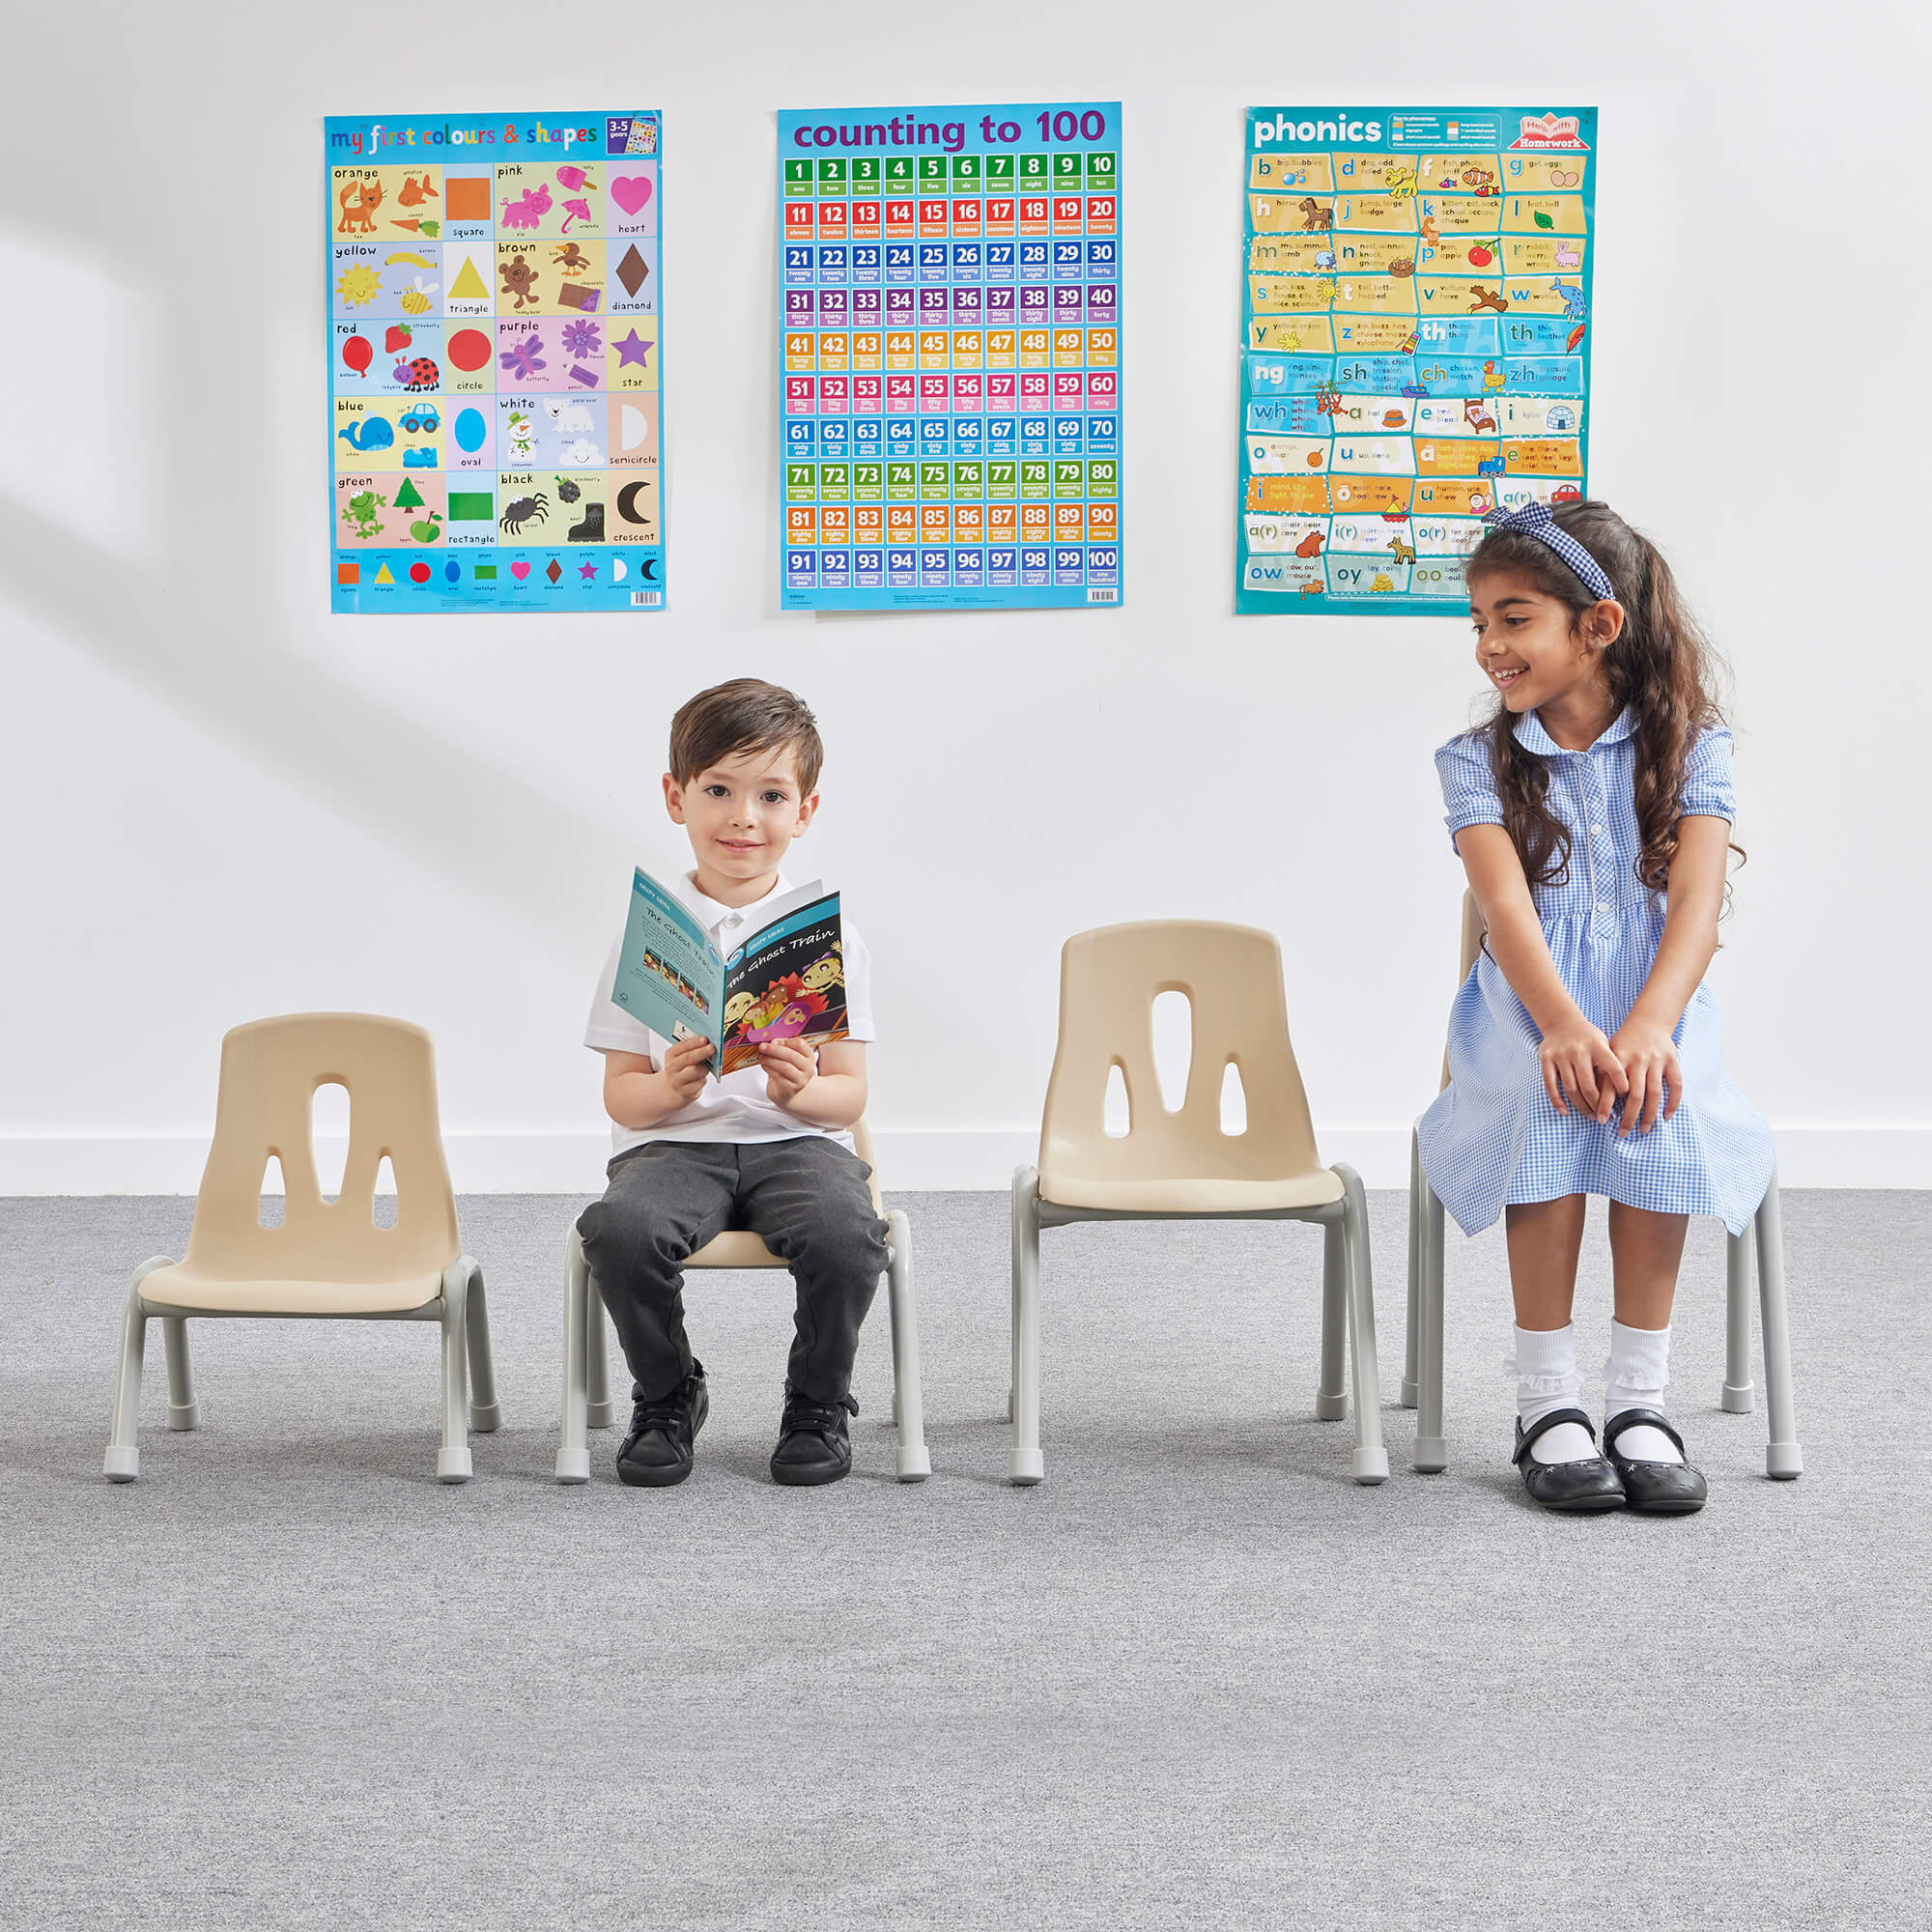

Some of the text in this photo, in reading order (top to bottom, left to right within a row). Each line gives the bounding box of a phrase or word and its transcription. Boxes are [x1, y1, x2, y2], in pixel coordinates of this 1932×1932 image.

[610, 122, 628, 131] 3-5
[794, 110, 1105, 152] counting to 100
[1255, 113, 1381, 148] phonics
[1527, 121, 1571, 132] Help with
[331, 122, 597, 155] my first colours & shapes
[1520, 138, 1581, 148] Homework
[497, 165, 523, 179] pink
[796, 157, 1111, 178] 1 2 3 4 5 6 7 8 9 10
[1259, 158, 1271, 175] b
[1342, 158, 1354, 176] d
[1422, 158, 1433, 177] f
[1510, 158, 1522, 176] g
[334, 168, 378, 180] orange
[1257, 197, 1270, 216] h
[1343, 199, 1351, 220] j
[1423, 199, 1434, 216] k
[452, 229, 484, 238] square
[618, 224, 645, 233] heart
[335, 245, 377, 258] yellow
[498, 243, 536, 253] brown
[1257, 245, 1277, 258] m
[1343, 245, 1355, 259] n
[1422, 246, 1435, 263] p
[1514, 243, 1521, 256] r
[1258, 287, 1267, 299] s
[1344, 283, 1352, 300] t
[1424, 289, 1435, 300] v
[1512, 290, 1530, 300] w
[450, 305, 489, 314] triangle
[612, 301, 651, 310] diamond
[337, 324, 356, 333] red
[499, 321, 539, 333] purple
[1342, 327, 1352, 339] z
[1421, 323, 1446, 341] th
[1511, 324, 1533, 341] th
[1256, 327, 1267, 342] y
[790, 333, 1113, 352] 41 42 43 44 45 46 47 48 49 50
[1257, 365, 1284, 384] ng
[1343, 363, 1367, 381] sh
[1421, 364, 1447, 381] ch
[1509, 364, 1536, 382] zh
[338, 401, 364, 411] blue
[499, 398, 535, 409] white
[1255, 401, 1288, 418] wh
[1350, 407, 1362, 418] a
[1421, 408, 1432, 419] e
[1509, 404, 1513, 420] i
[1254, 447, 1265, 459] o
[1341, 448, 1352, 460] u
[610, 456, 657, 465] semicircle
[338, 477, 373, 488] green
[501, 474, 533, 484] black
[448, 535, 496, 544] rectangle
[613, 533, 654, 542] crescent
[791, 552, 1116, 569] 91 92 93 94 95 96 97 98 99 100
[1251, 567, 1282, 579] ow
[1337, 568, 1362, 584] oy
[1416, 570, 1441, 582] oo
[646, 908, 661, 923] The
[727, 971, 746, 988] The
[748, 946, 785, 972] Ghost
[789, 929, 835, 950] Train
